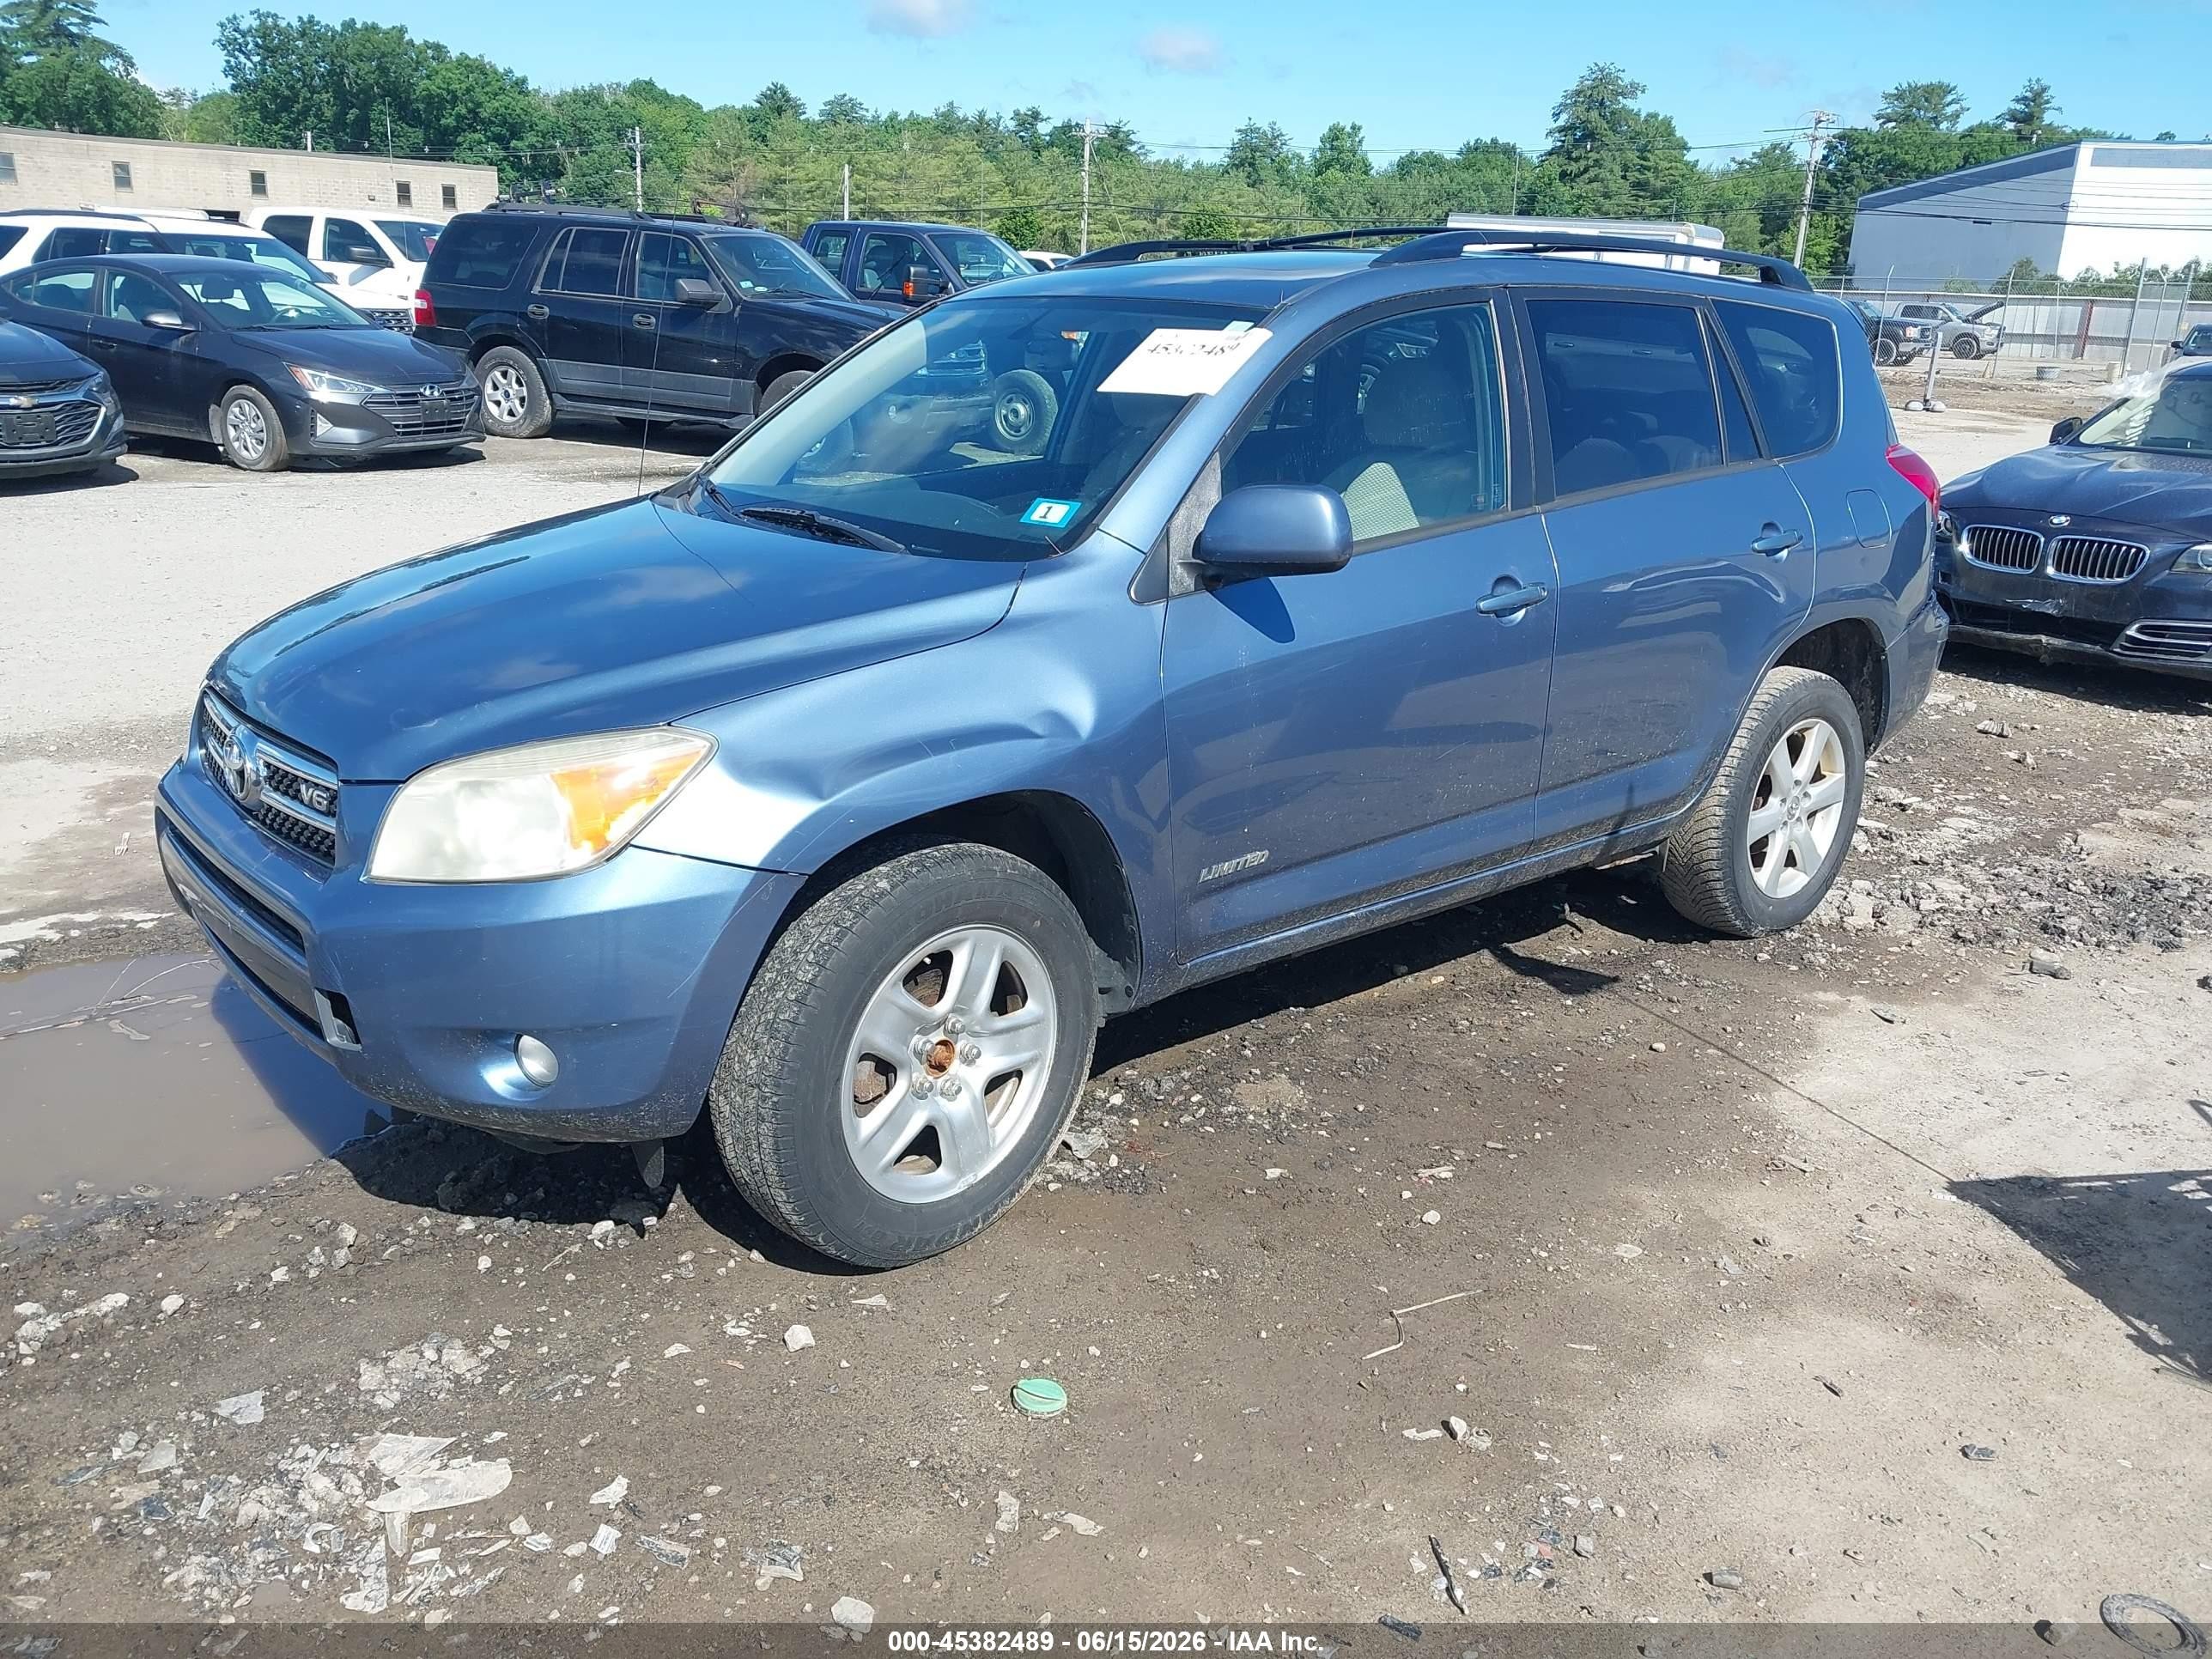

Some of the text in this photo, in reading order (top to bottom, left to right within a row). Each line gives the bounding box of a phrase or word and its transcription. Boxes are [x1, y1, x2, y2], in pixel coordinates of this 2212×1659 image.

[1039, 506, 1053, 519] 1
[300, 782, 330, 812] V6
[1199, 849, 1269, 883] LIMITED
